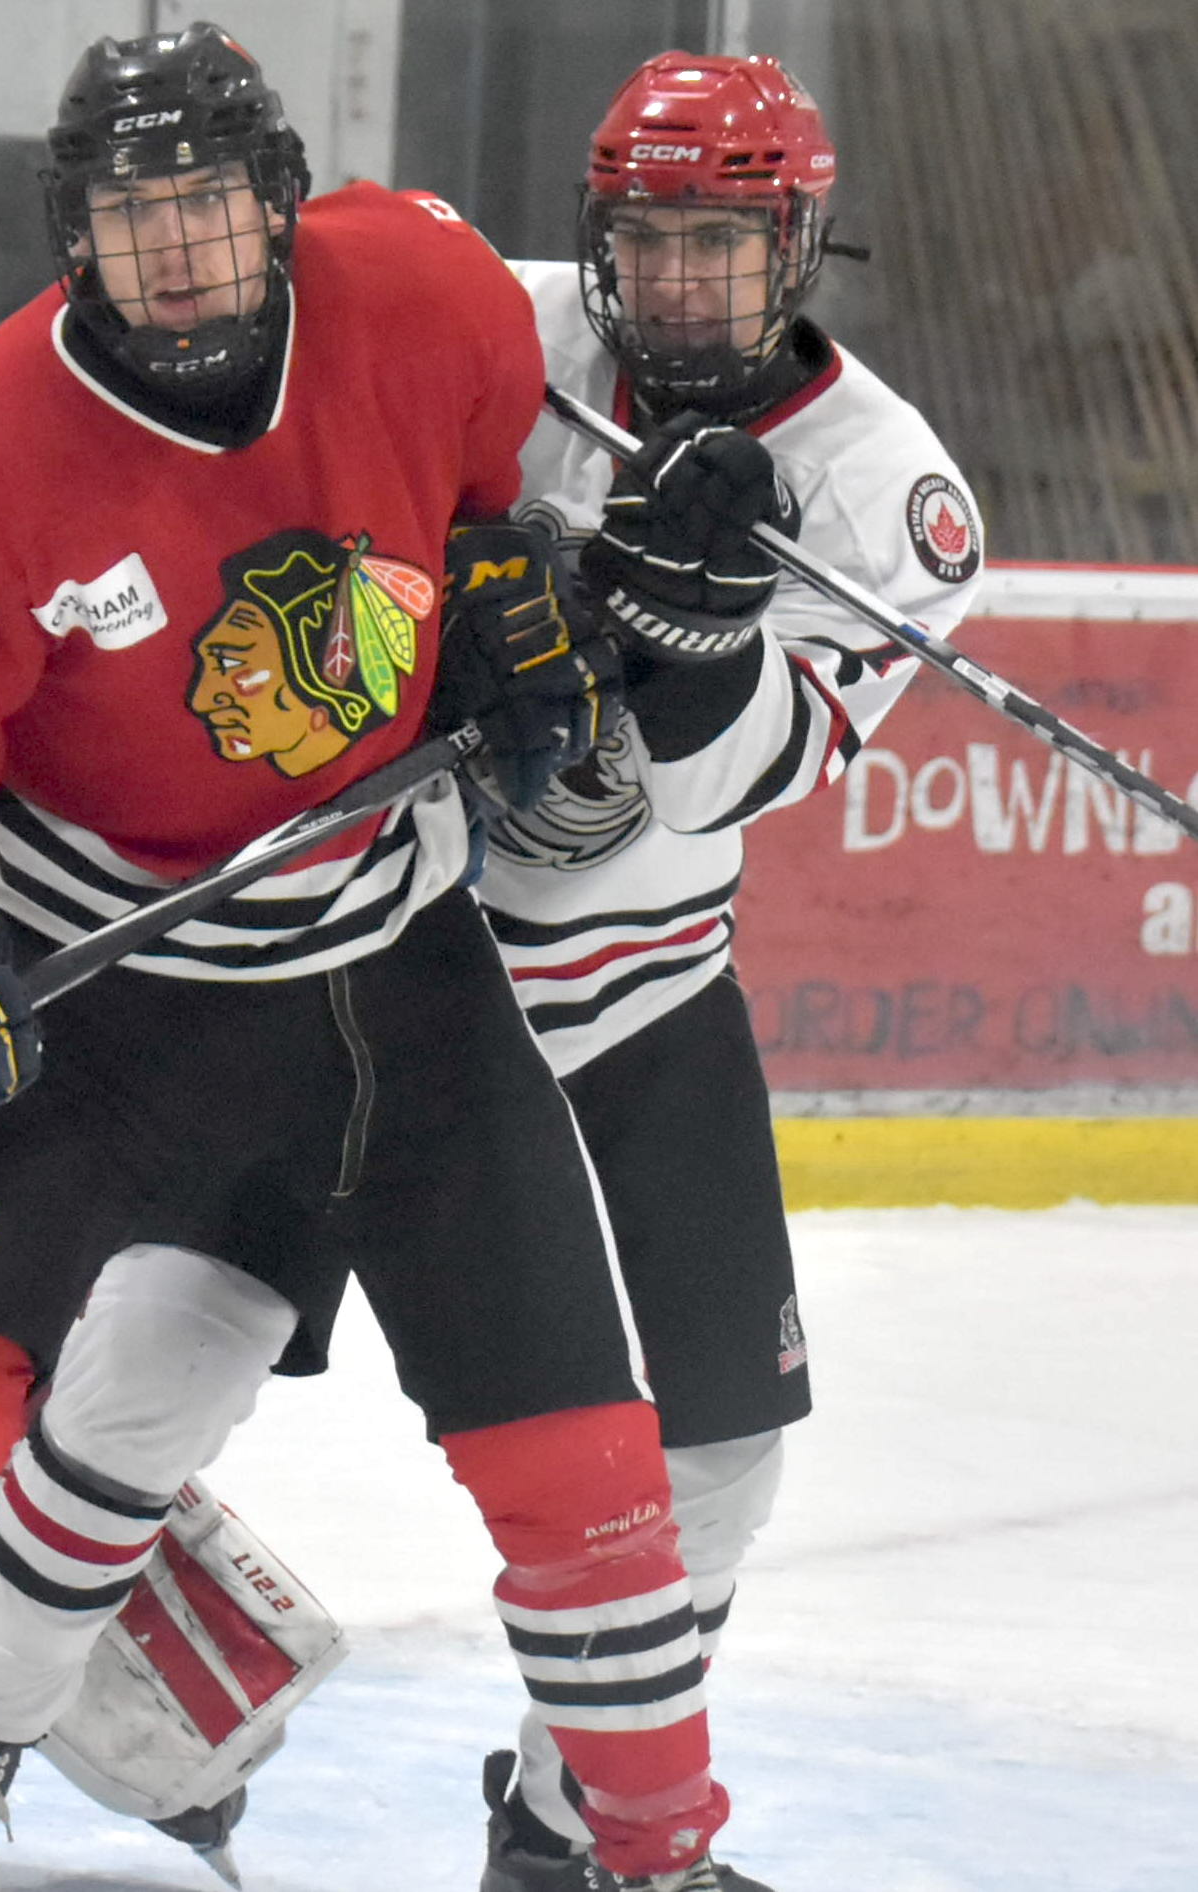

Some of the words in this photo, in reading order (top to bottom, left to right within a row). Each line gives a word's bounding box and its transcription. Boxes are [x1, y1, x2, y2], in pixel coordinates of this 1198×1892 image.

[113, 109, 183, 132] CCM
[630, 144, 702, 162] CCM
[1141, 880, 1198, 956] a
[232, 1553, 295, 1614] L12.2
